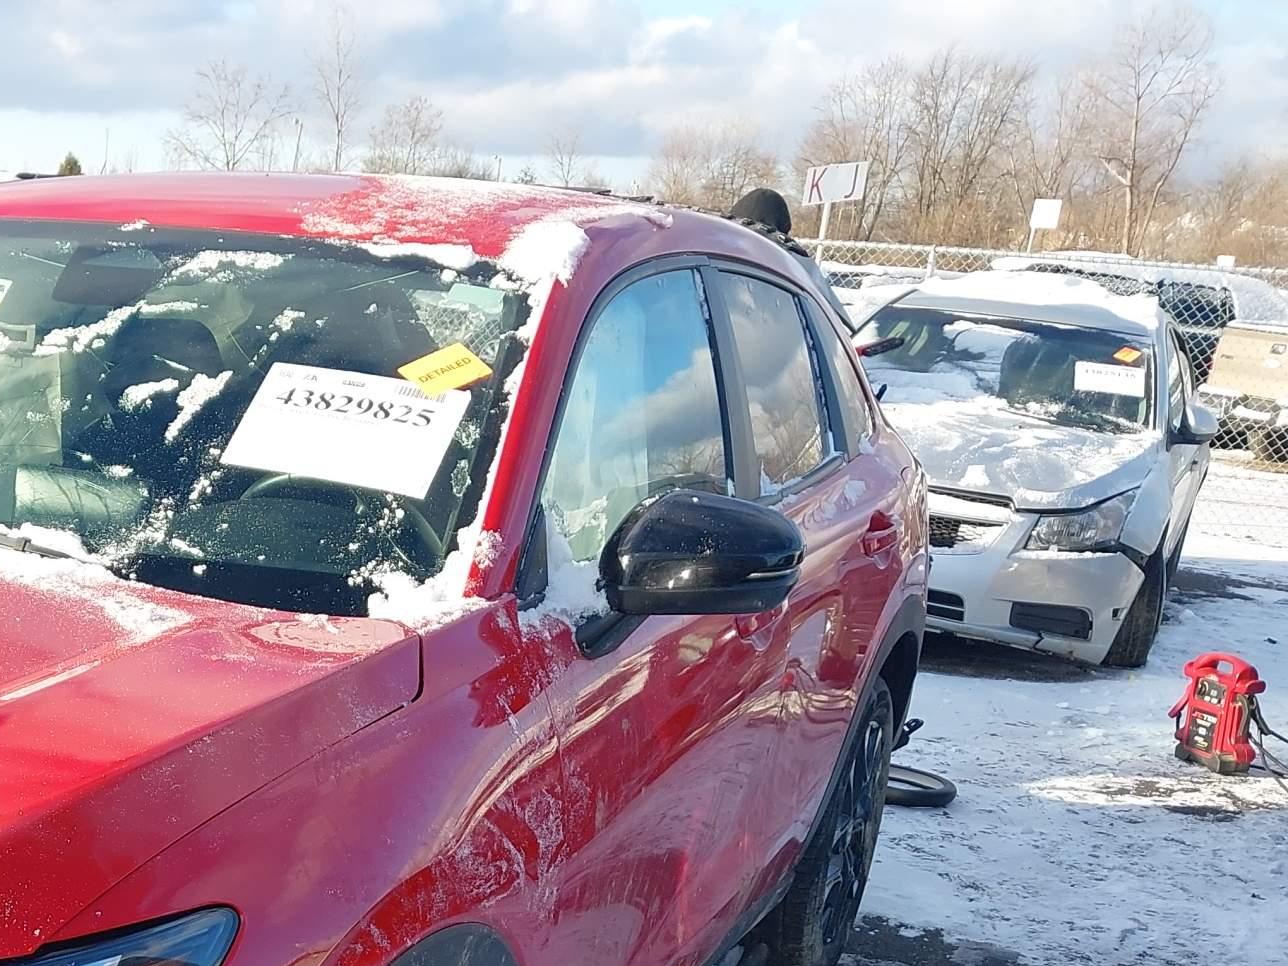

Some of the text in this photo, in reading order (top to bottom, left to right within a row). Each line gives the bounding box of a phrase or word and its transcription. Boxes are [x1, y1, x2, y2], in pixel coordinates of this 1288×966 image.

[808, 163, 860, 204] K J
[418, 356, 472, 384] DETAILED
[276, 387, 436, 427] 43829825
